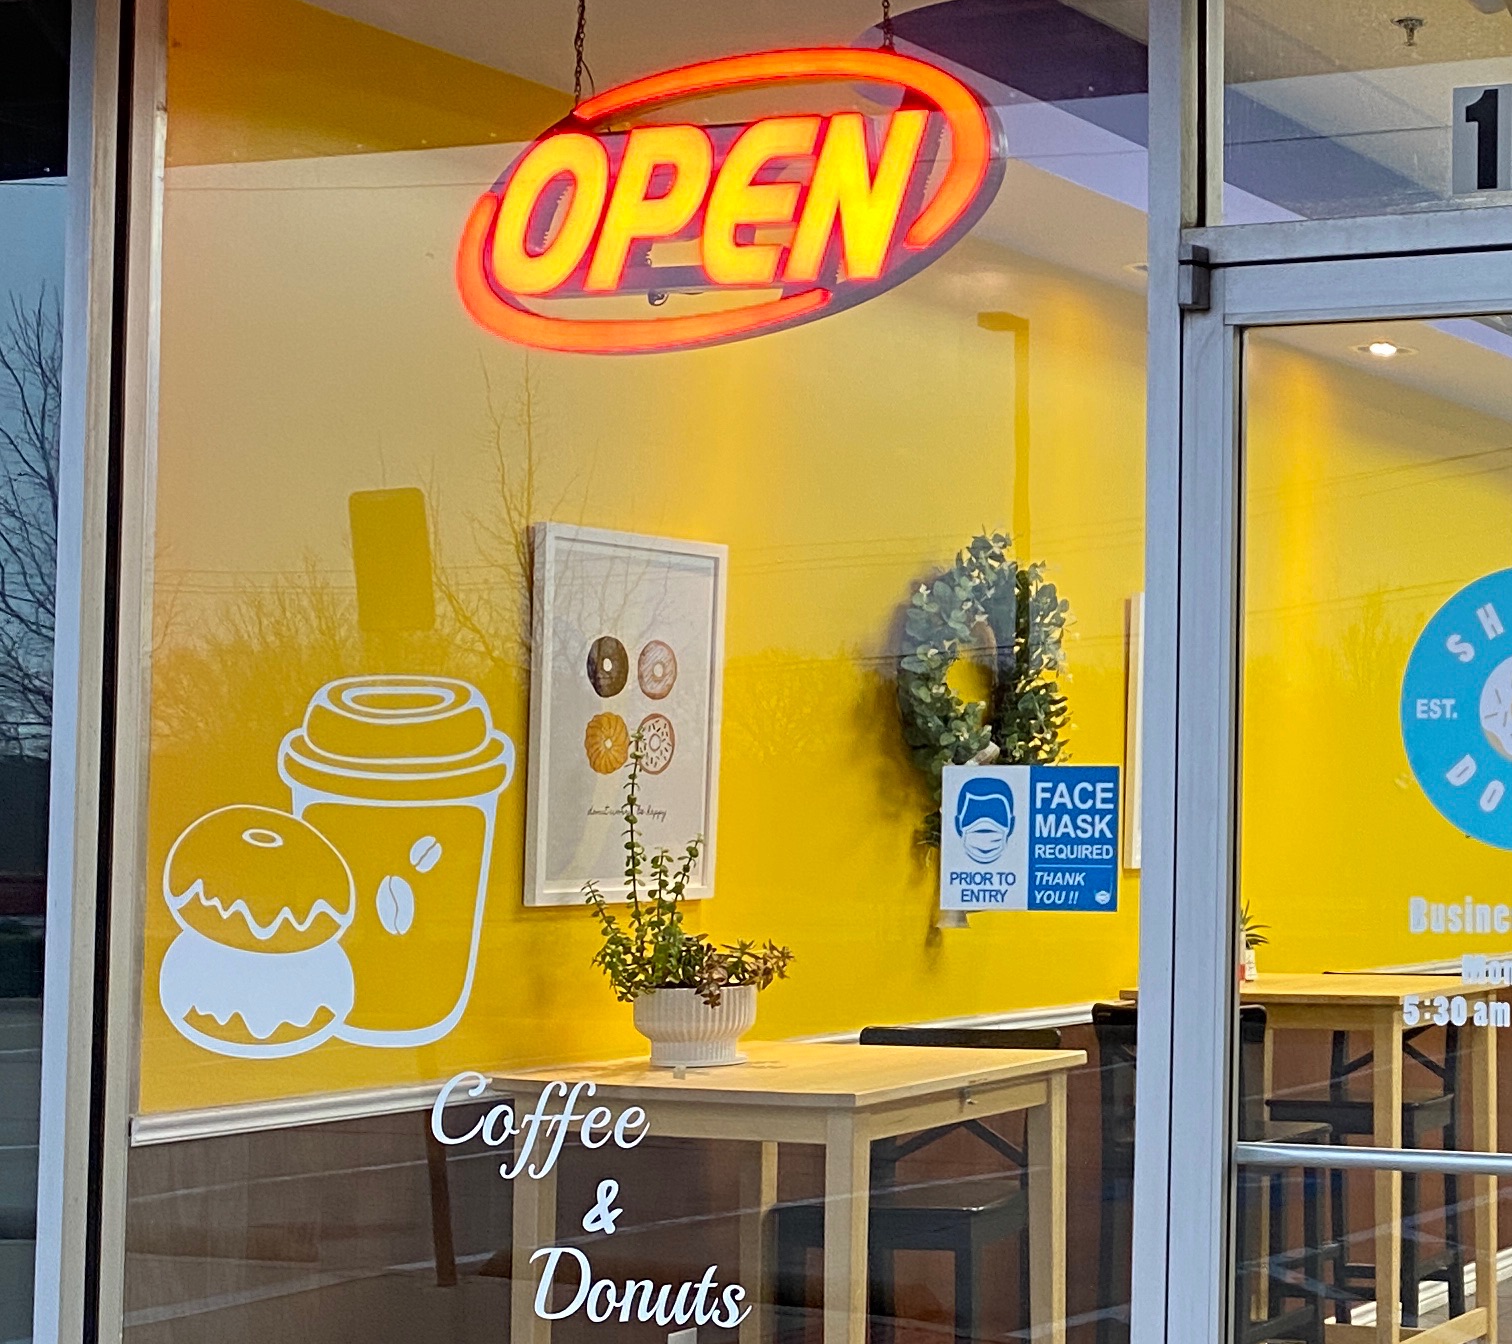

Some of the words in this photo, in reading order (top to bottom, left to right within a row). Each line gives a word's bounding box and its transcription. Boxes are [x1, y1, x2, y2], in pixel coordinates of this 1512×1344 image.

[491, 109, 930, 295] OPEN
[1415, 698, 1458, 720] EST.
[1034, 781, 1115, 810] FACE
[1034, 814, 1114, 839] MASK
[1034, 844, 1114, 860] REQUIRED
[949, 871, 994, 886] PRIOR
[996, 872, 1016, 886] TO
[1034, 872, 1086, 886] THANK
[960, 889, 1009, 903] ENTRY
[1034, 890, 1067, 904] YOU
[1402, 996, 1468, 1027] 5:30
[1472, 1002, 1511, 1028] am
[431, 1071, 651, 1180] Coffee
[582, 1178, 624, 1235] &
[529, 1246, 753, 1329] Donuts
